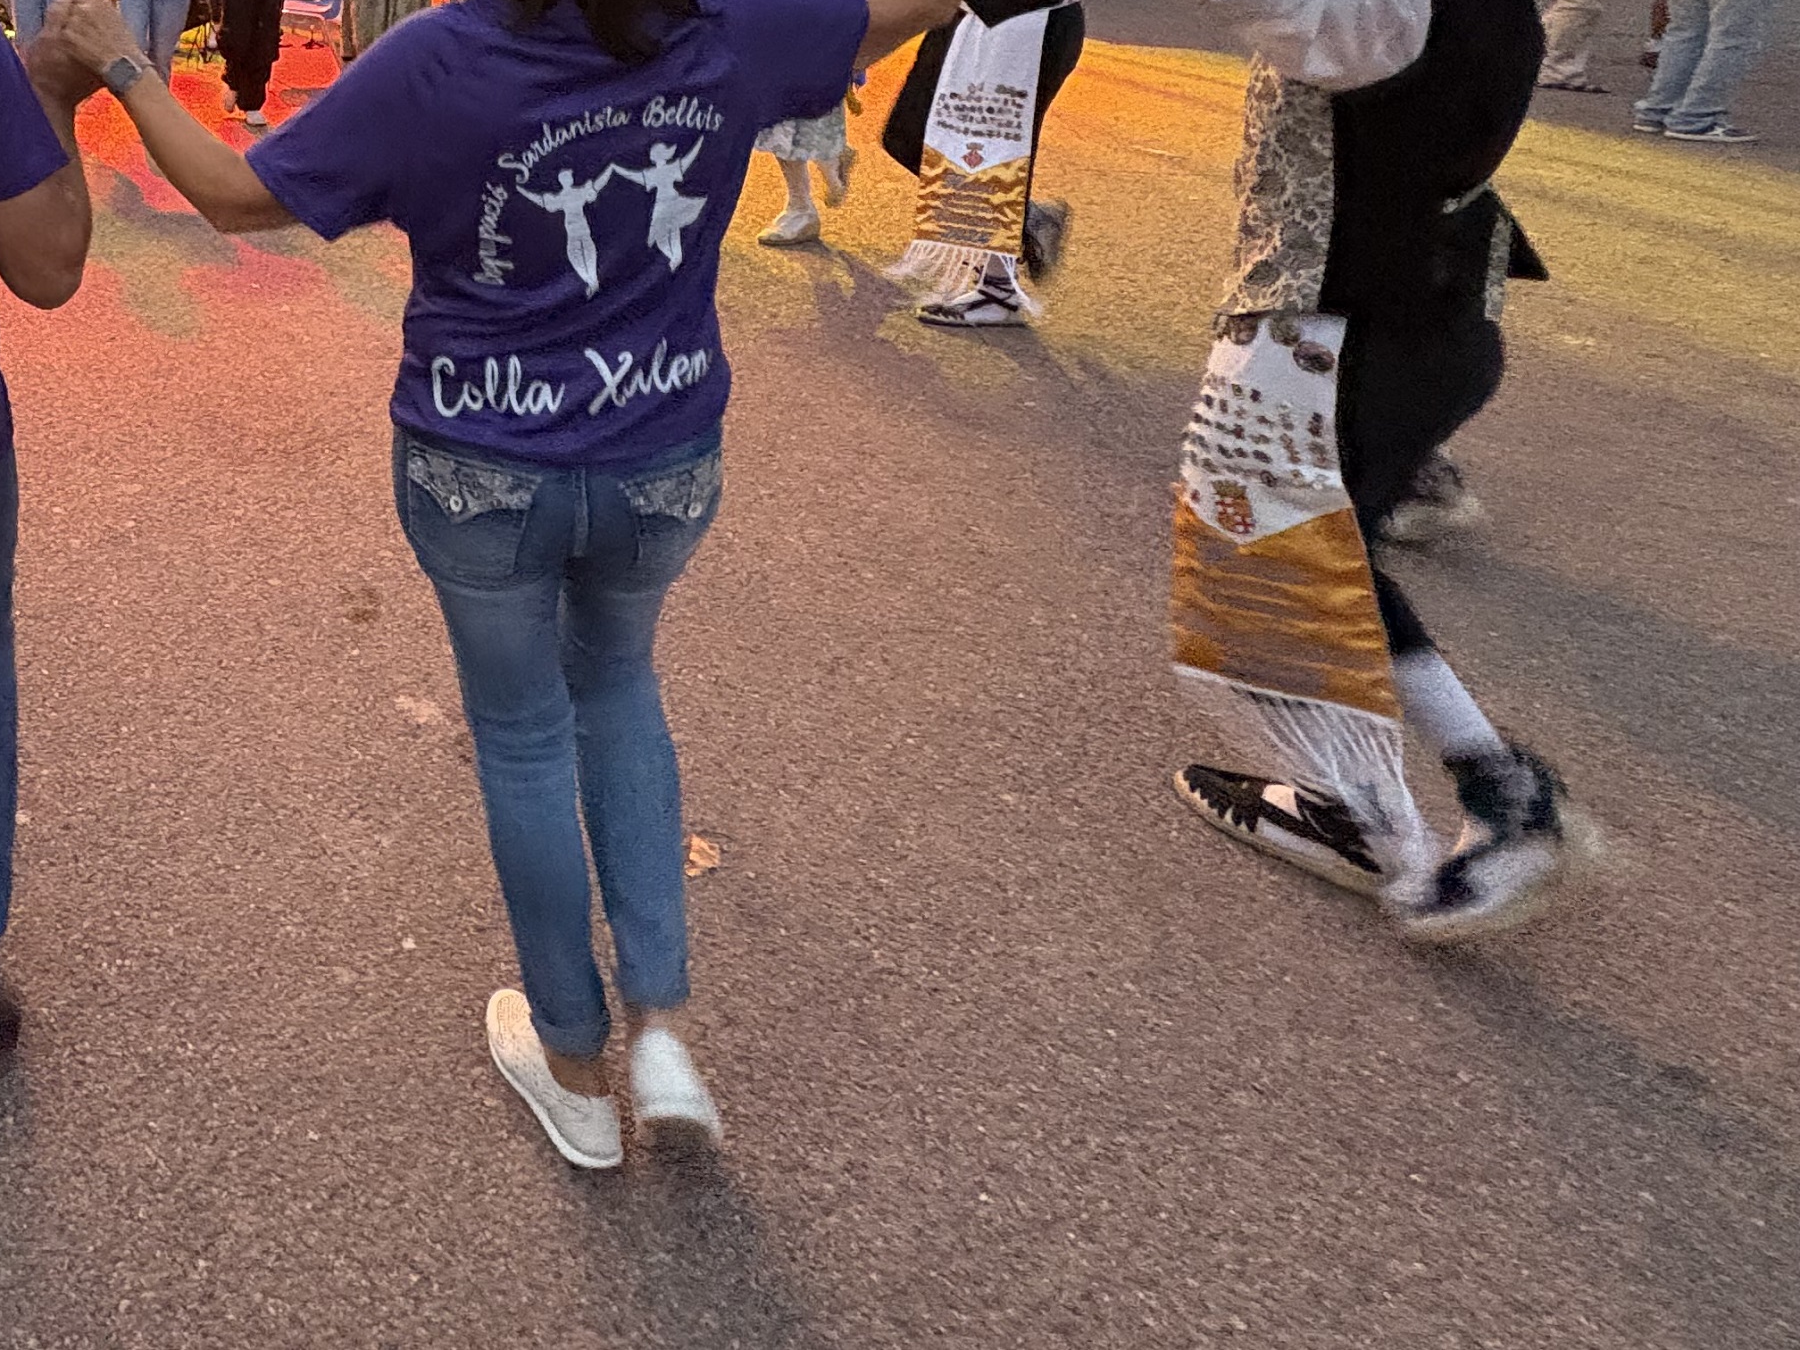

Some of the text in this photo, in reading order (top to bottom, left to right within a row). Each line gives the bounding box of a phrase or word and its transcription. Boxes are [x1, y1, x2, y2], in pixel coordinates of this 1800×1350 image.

[497, 106, 632, 184] Sardanista
[431, 337, 713, 418] Colla Xalem
